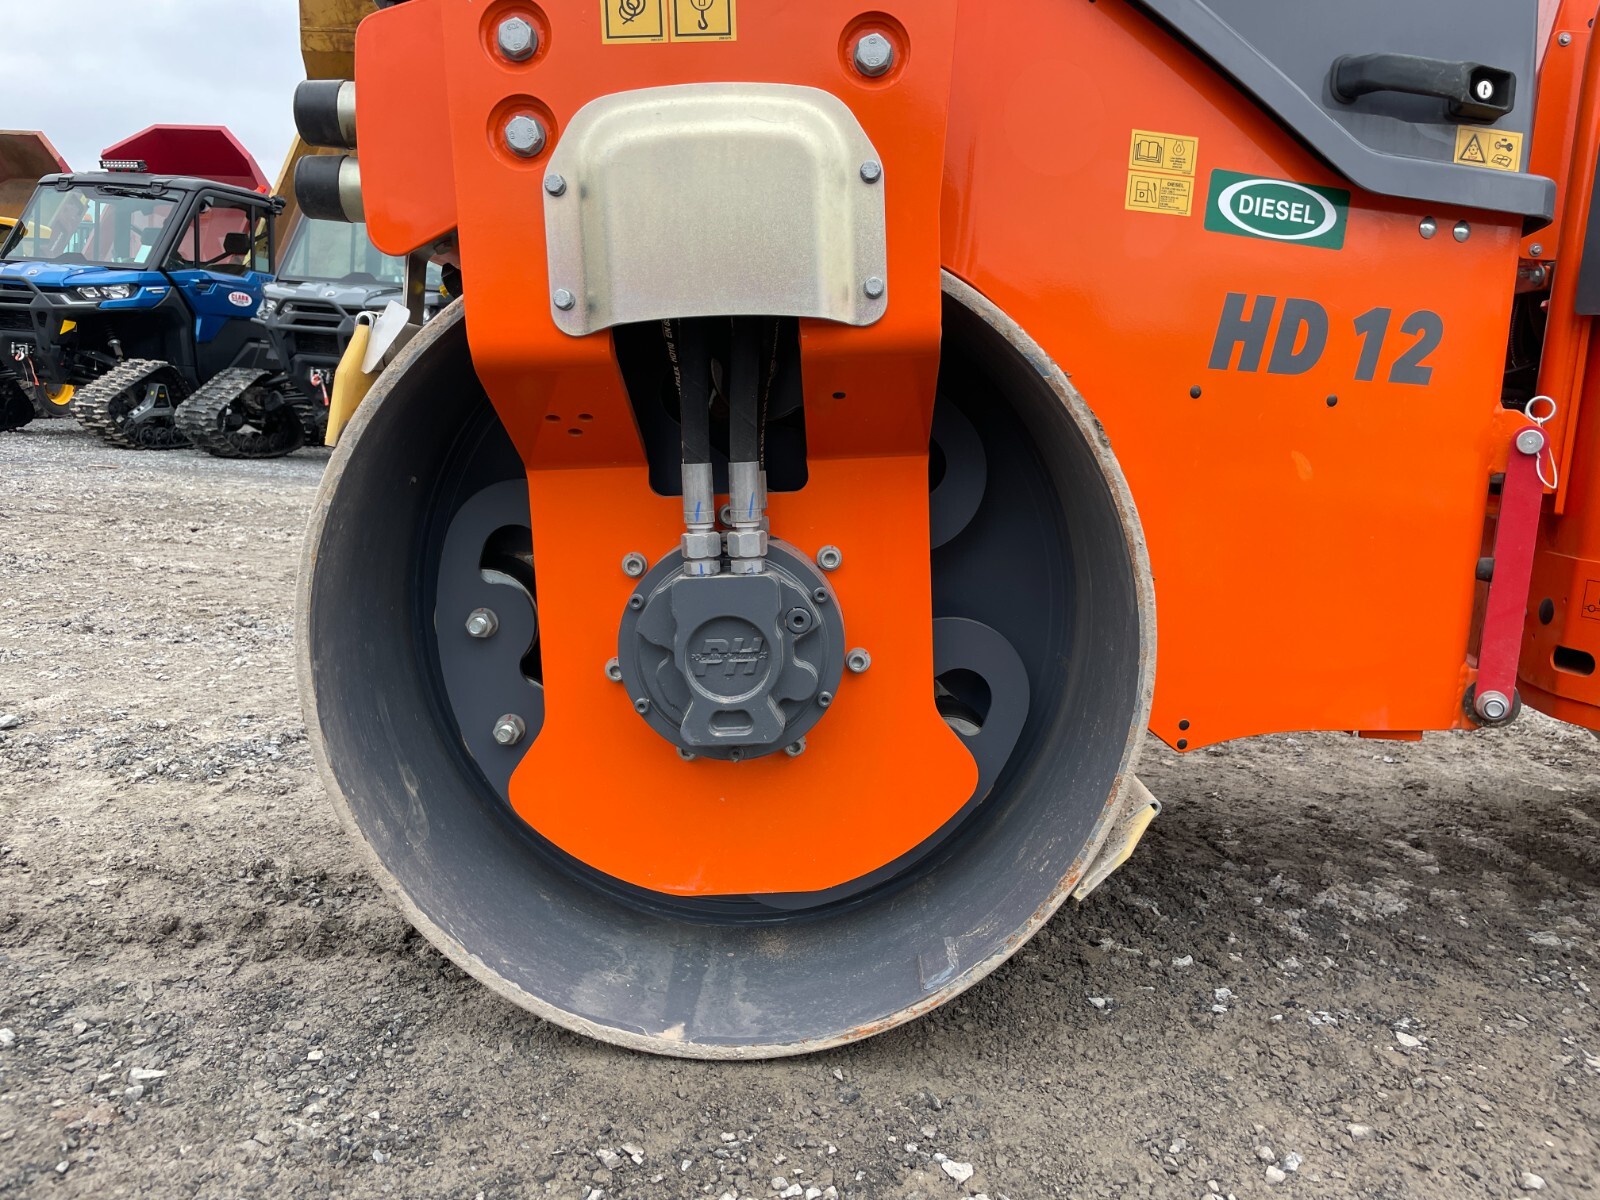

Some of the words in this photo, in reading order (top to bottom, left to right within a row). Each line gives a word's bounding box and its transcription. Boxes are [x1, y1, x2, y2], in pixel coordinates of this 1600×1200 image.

[1238, 193, 1316, 225] DIESEL
[1207, 291, 1330, 376] HD
[1353, 306, 1444, 386] 12
[695, 638, 763, 677] PH
